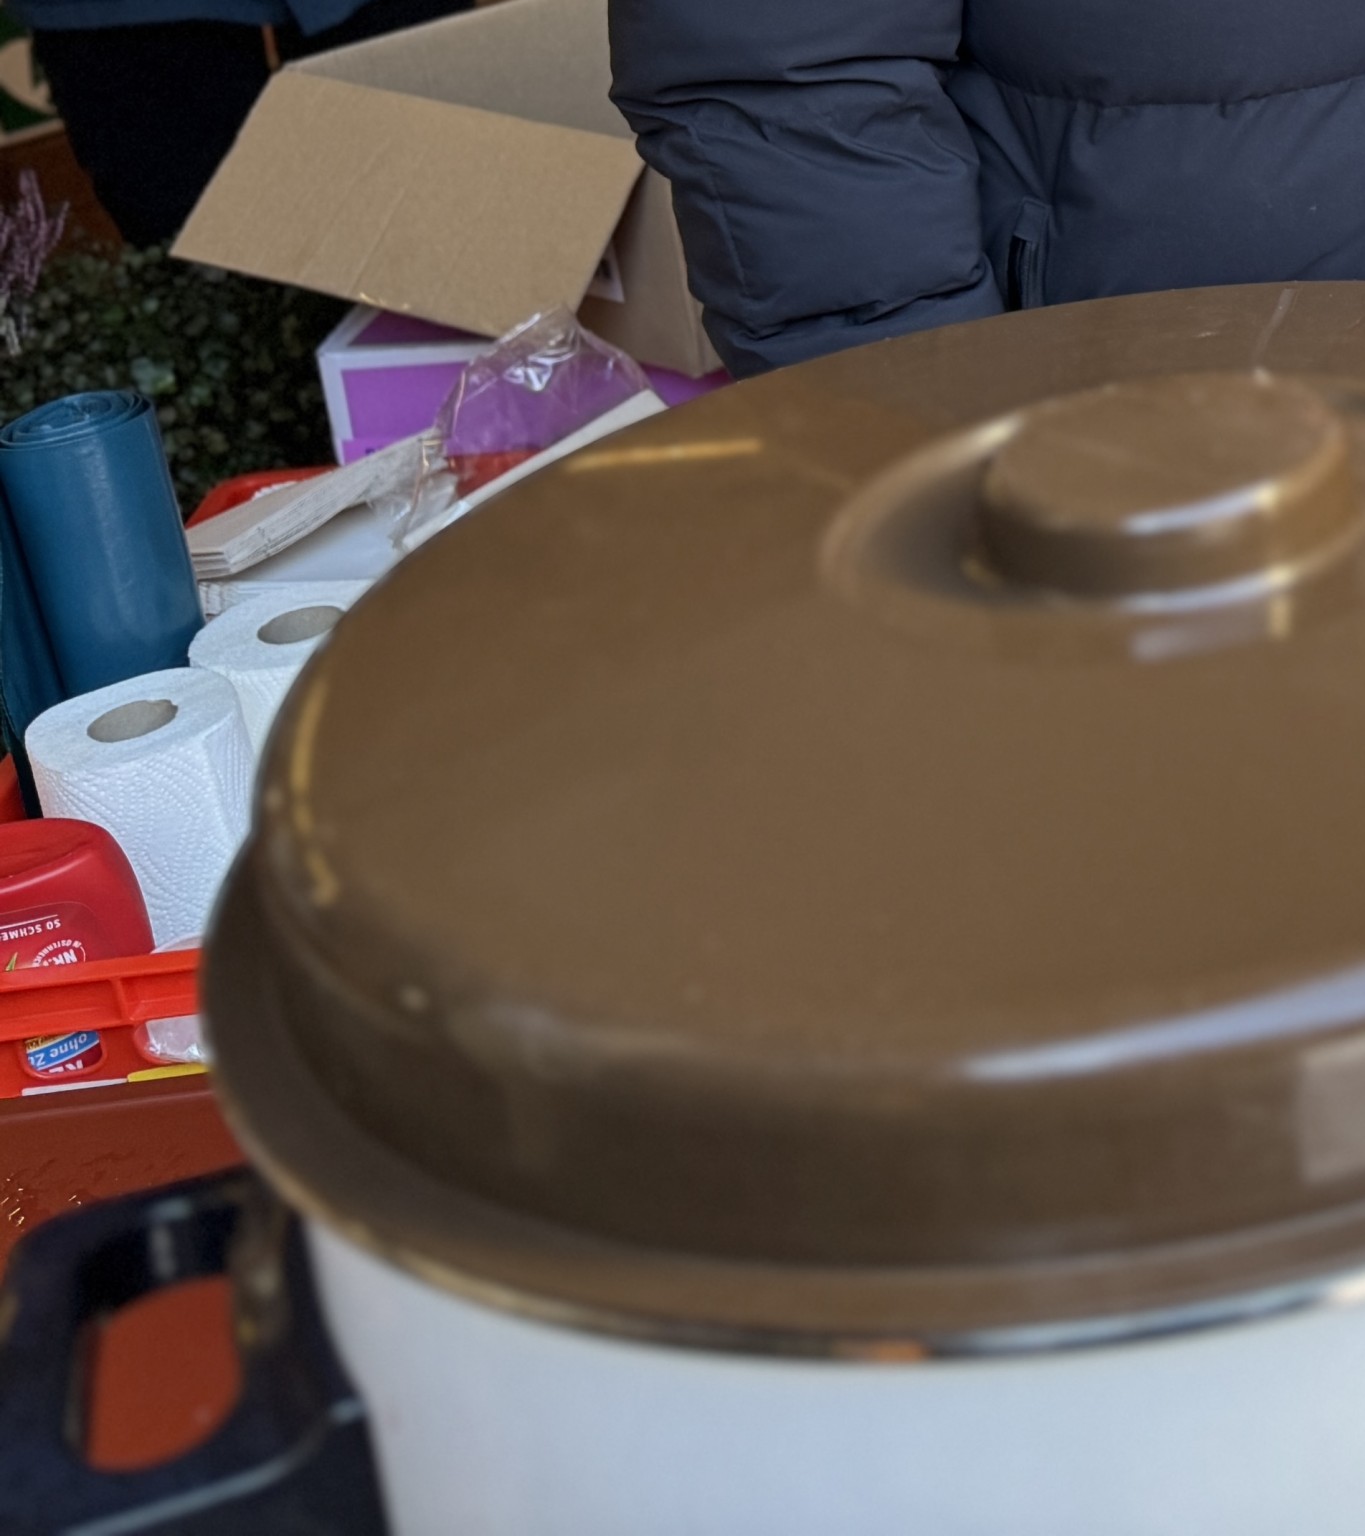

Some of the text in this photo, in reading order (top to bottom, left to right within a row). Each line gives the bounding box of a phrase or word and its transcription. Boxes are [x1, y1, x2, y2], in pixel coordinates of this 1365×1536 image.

[0, 918, 62, 942] SO SCHME
[49, 1033, 87, 1058] ohne
